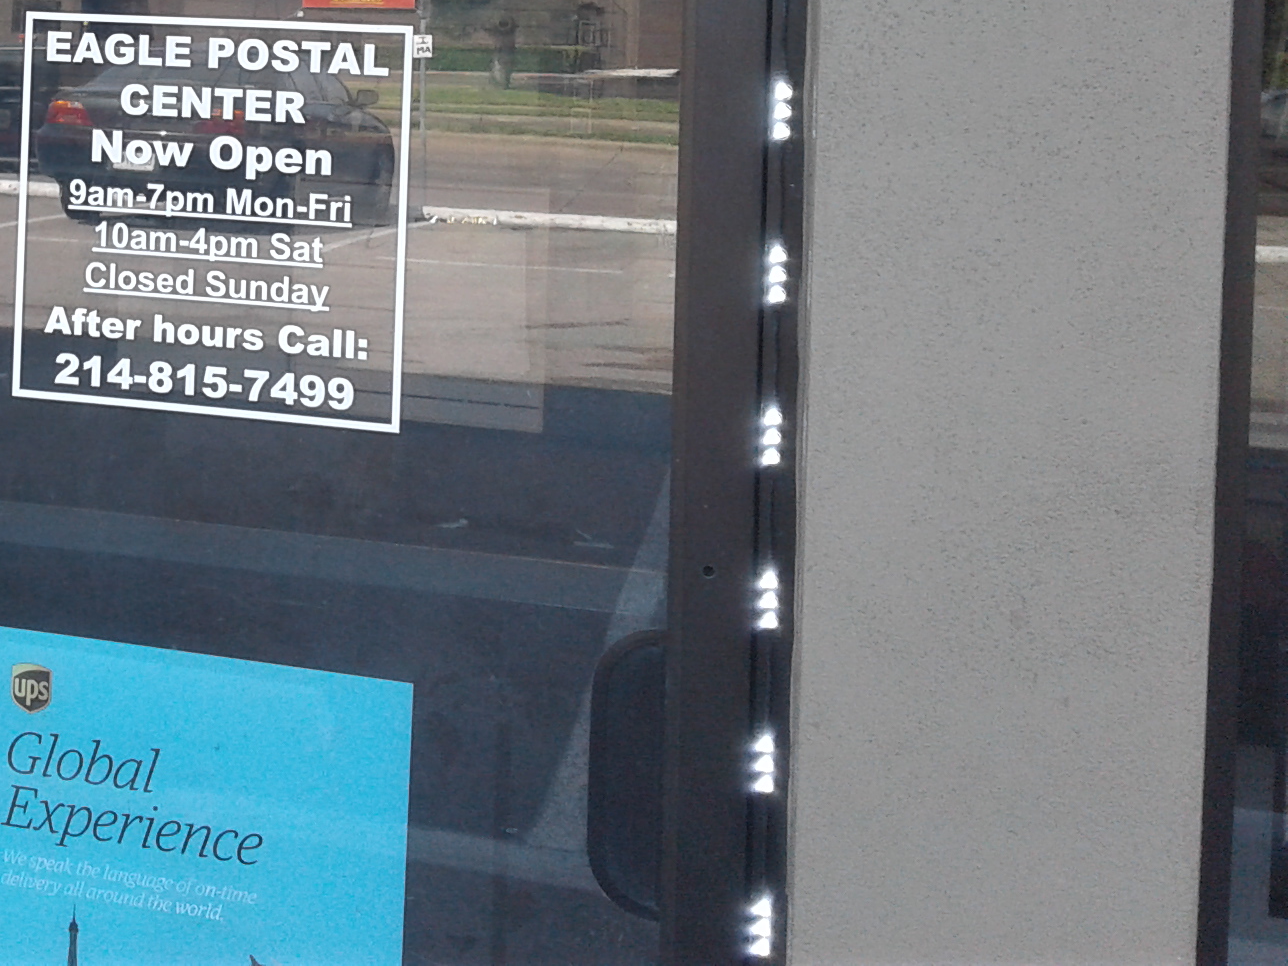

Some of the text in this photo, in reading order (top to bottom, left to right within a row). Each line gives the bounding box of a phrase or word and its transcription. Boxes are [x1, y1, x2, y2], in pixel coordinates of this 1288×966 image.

[46, 30, 390, 77] EAGLE POSTAL
[120, 83, 306, 124] CENTER
[90, 129, 332, 179] Now Open
[69, 179, 352, 222] 9am-7pm Mon-Fri
[95, 222, 323, 263] 10am-4pm Sat
[85, 262, 330, 312] Closed Sunday
[44, 306, 370, 361] After hours Call:
[54, 352, 355, 411] 214-815-7499
[14, 677, 49, 706] ups
[6, 730, 160, 793] Global
[0, 784, 264, 866] Experience
[1, 871, 225, 922] delivery all around the world.
[28, 854, 73, 877] speak
[76, 859, 101, 879] the
[103, 865, 174, 891] language
[175, 878, 194, 896] of
[196, 884, 258, 905] on-time
